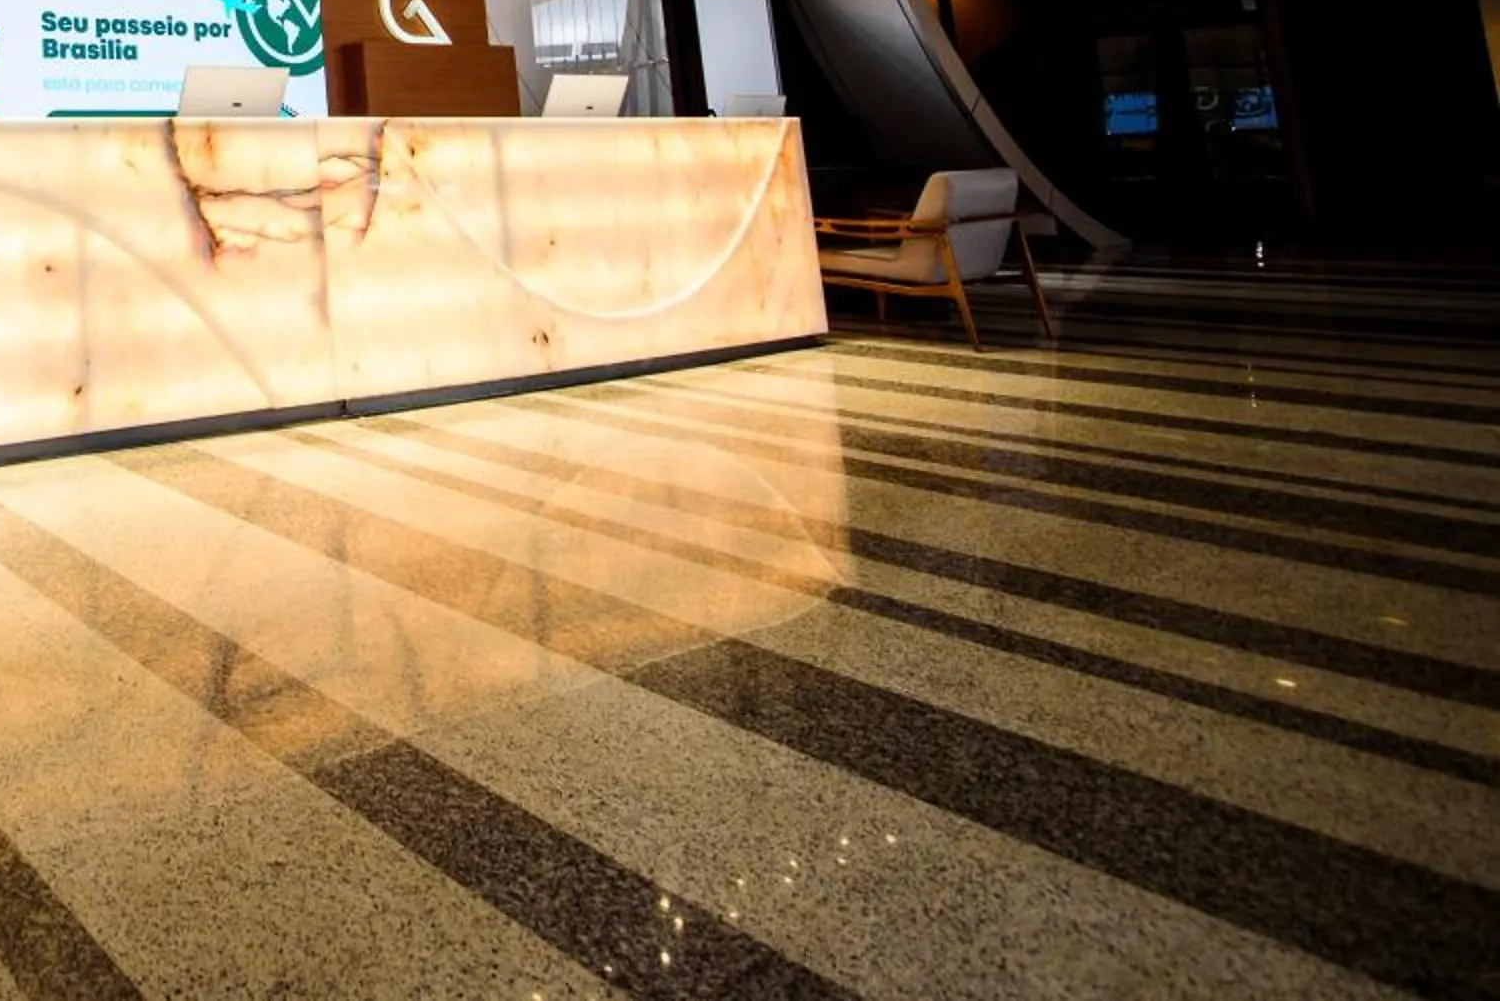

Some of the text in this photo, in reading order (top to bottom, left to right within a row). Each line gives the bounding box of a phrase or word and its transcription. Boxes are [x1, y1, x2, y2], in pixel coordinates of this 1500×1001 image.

[41, 11, 232, 40] Seu passeio por
